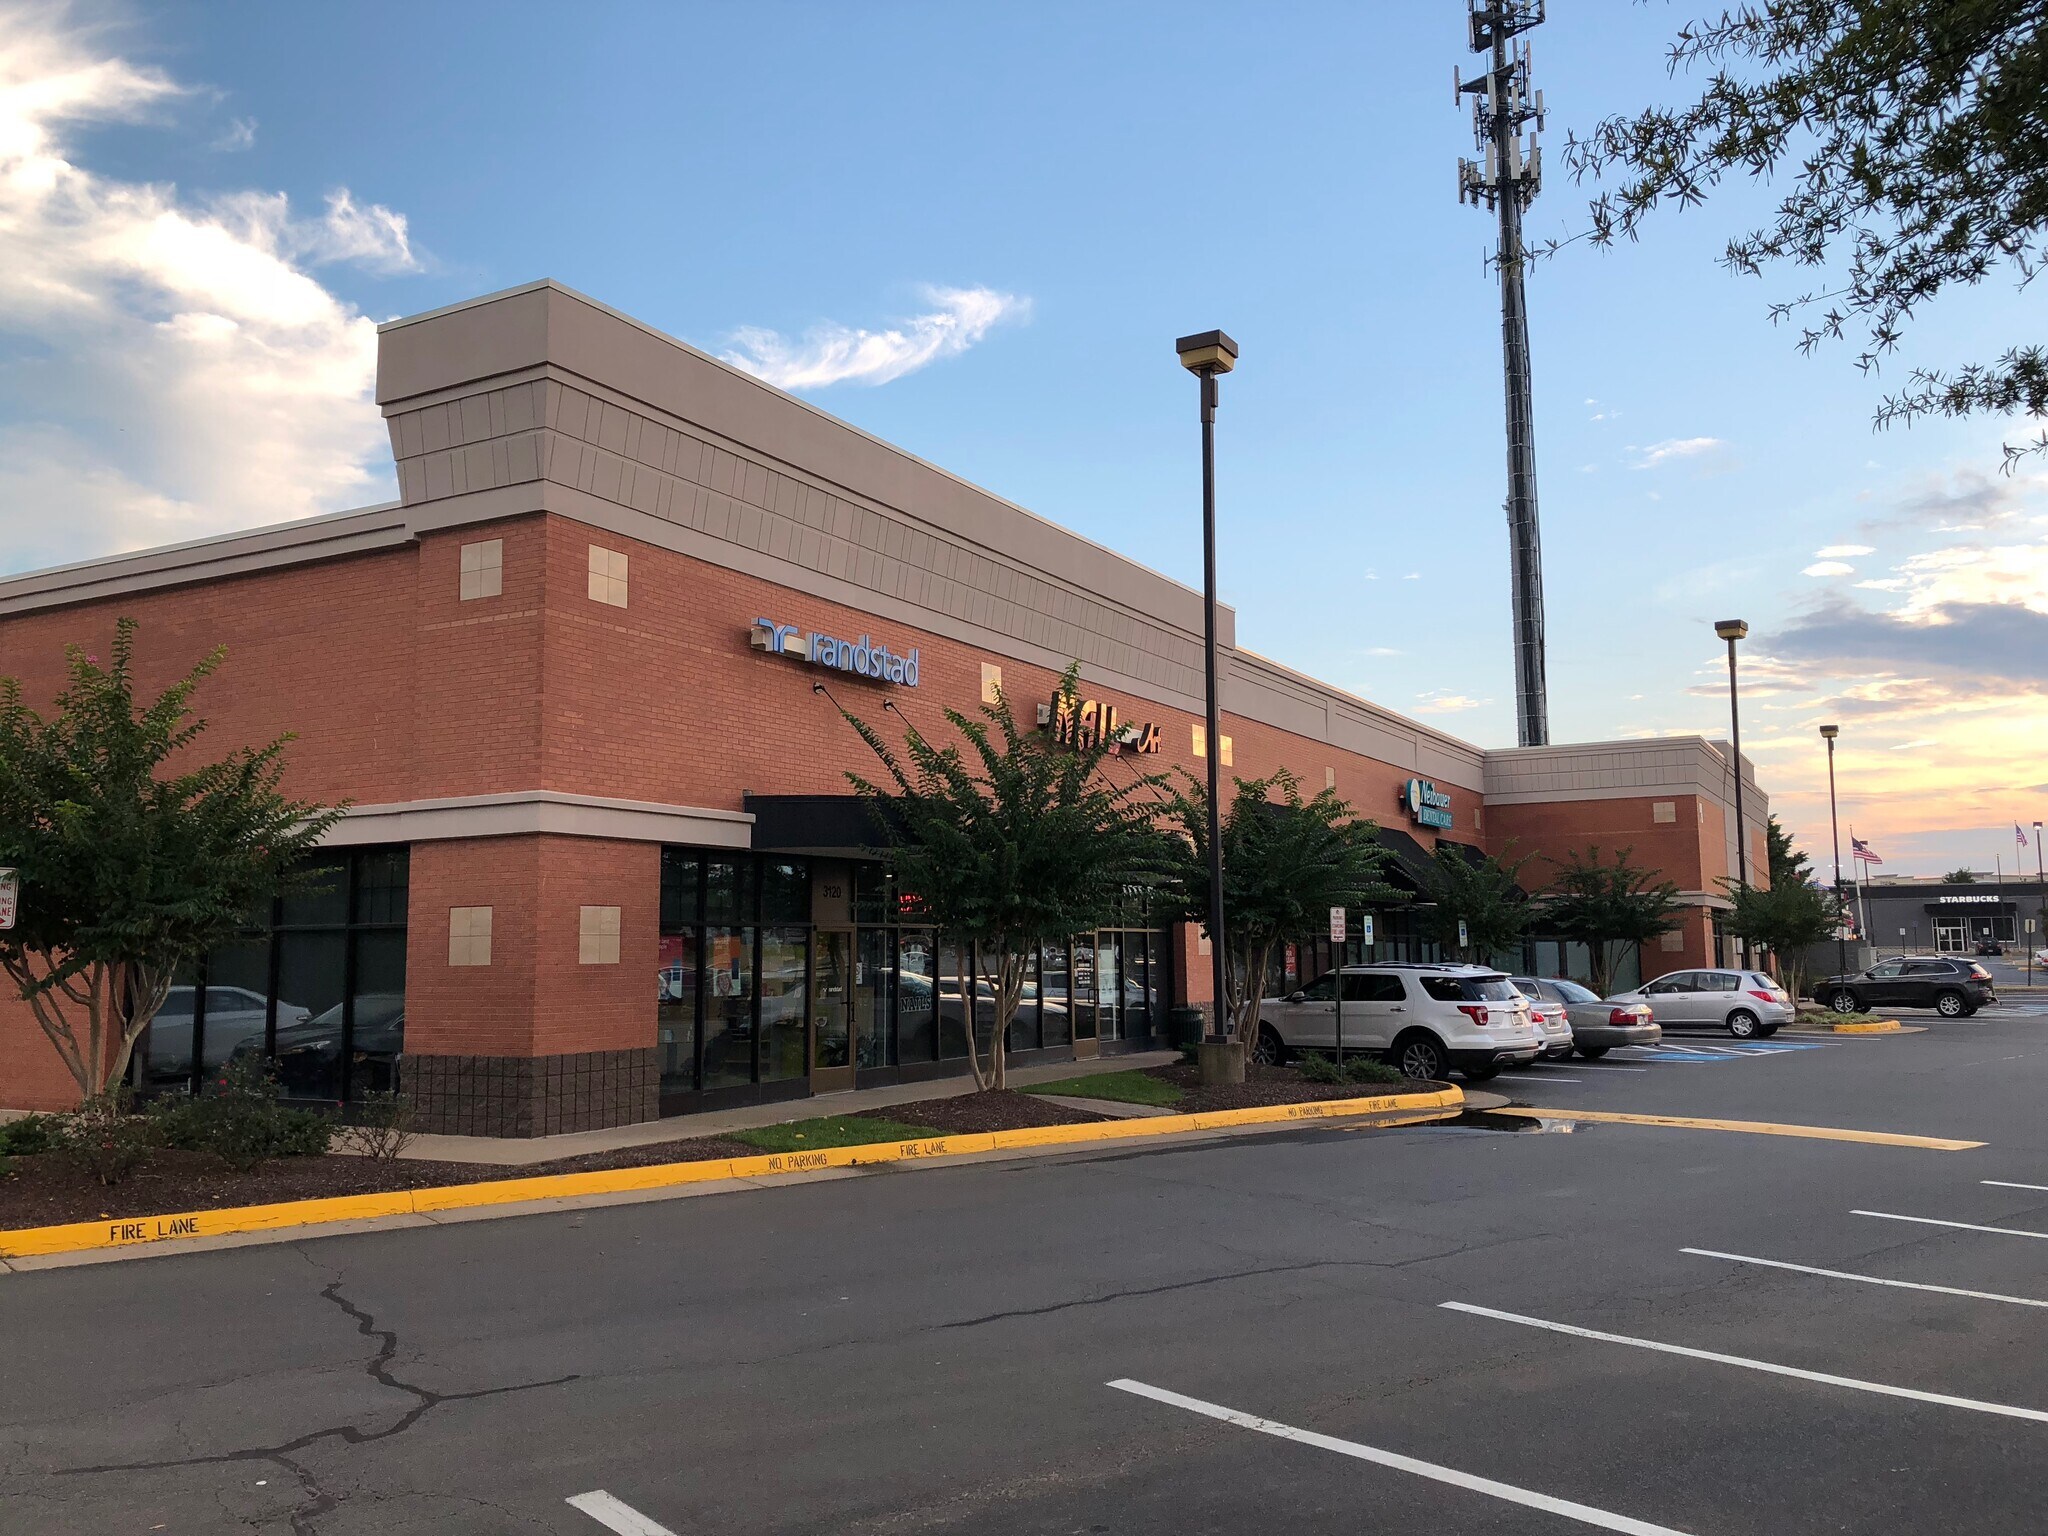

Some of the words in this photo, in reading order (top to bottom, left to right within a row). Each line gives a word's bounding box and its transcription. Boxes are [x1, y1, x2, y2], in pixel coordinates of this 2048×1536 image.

[811, 632, 919, 687] randstad
[823, 886, 841, 898] 3120
[900, 996, 932, 1013] NAILS
[1287, 1108, 1297, 1118] NO
[1299, 1105, 1324, 1116] PARKING
[1368, 1100, 1382, 1110] FIRE
[1384, 1098, 1398, 1108] LANE
[899, 1143, 919, 1157] FIRE
[924, 1140, 947, 1155] LANE
[768, 1157, 782, 1170] NO
[787, 1153, 828, 1169] PARKING
[110, 1223, 147, 1241] FIRE
[157, 1217, 200, 1236] LANE
